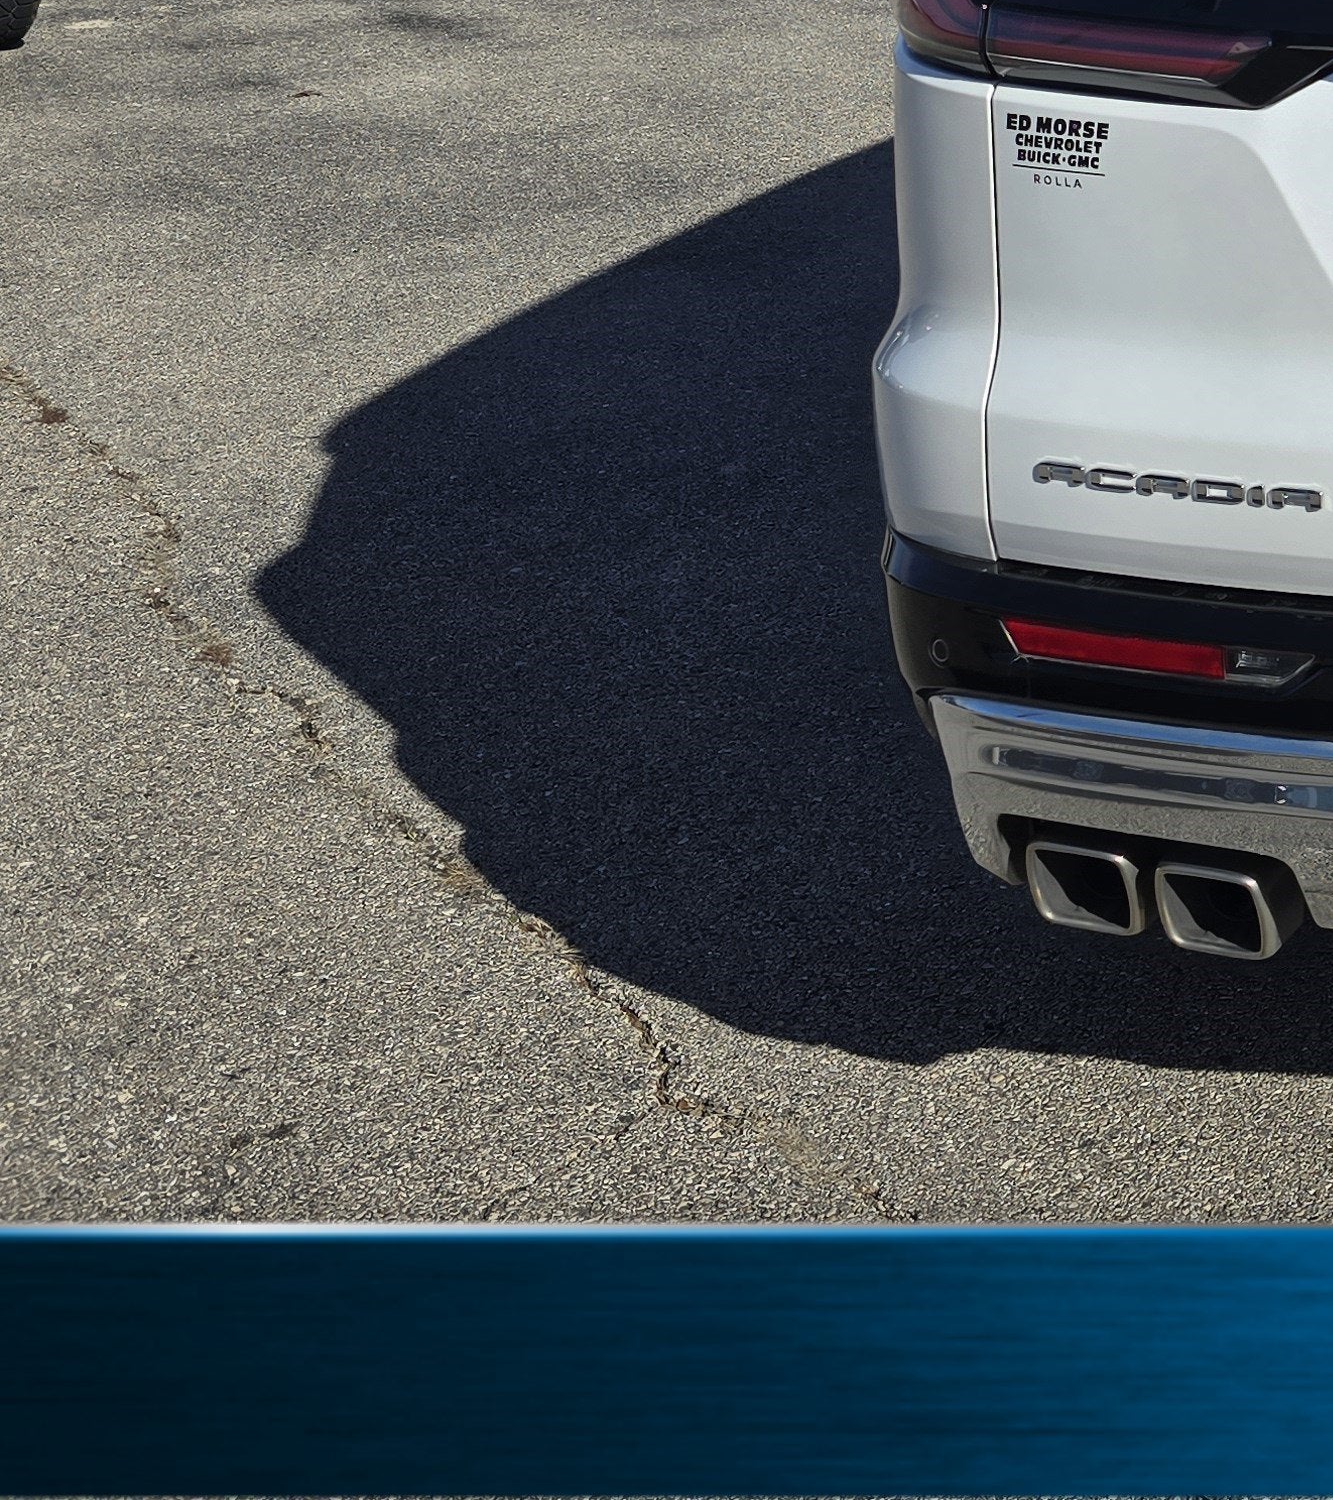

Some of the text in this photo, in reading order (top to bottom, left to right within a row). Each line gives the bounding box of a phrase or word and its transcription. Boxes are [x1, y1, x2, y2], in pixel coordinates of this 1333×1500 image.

[1006, 113, 1109, 140] ED MORSE
[1015, 132, 1103, 154] CHEVROLET
[1033, 173, 1083, 189] ROLLA
[1031, 460, 1325, 514] ACADIA
